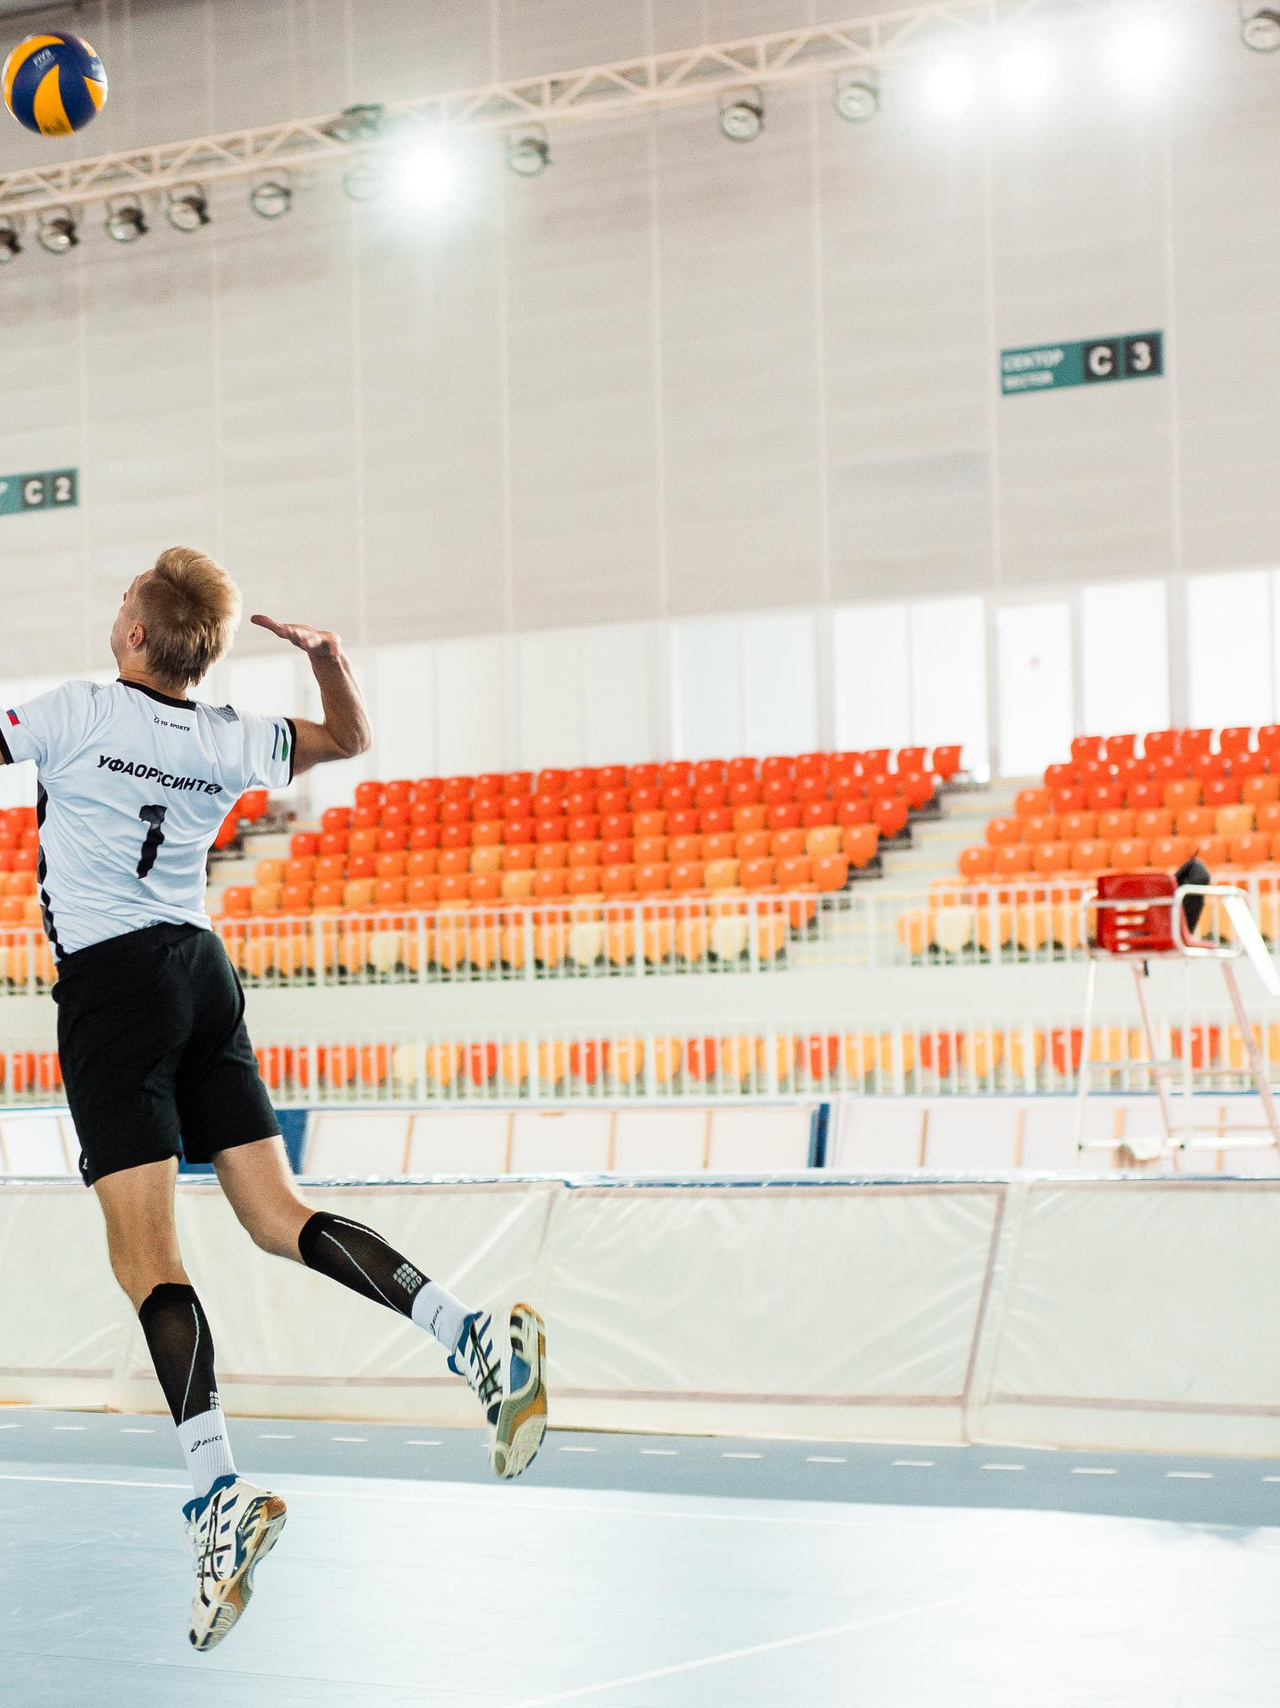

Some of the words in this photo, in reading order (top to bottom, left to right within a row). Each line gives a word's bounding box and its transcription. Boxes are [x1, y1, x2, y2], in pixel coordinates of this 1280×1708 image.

[1131, 340, 1152, 371] 3
[55, 476, 71, 502] 2
[169, 722, 191, 732] SPORTS
[136, 804, 167, 880] 1
